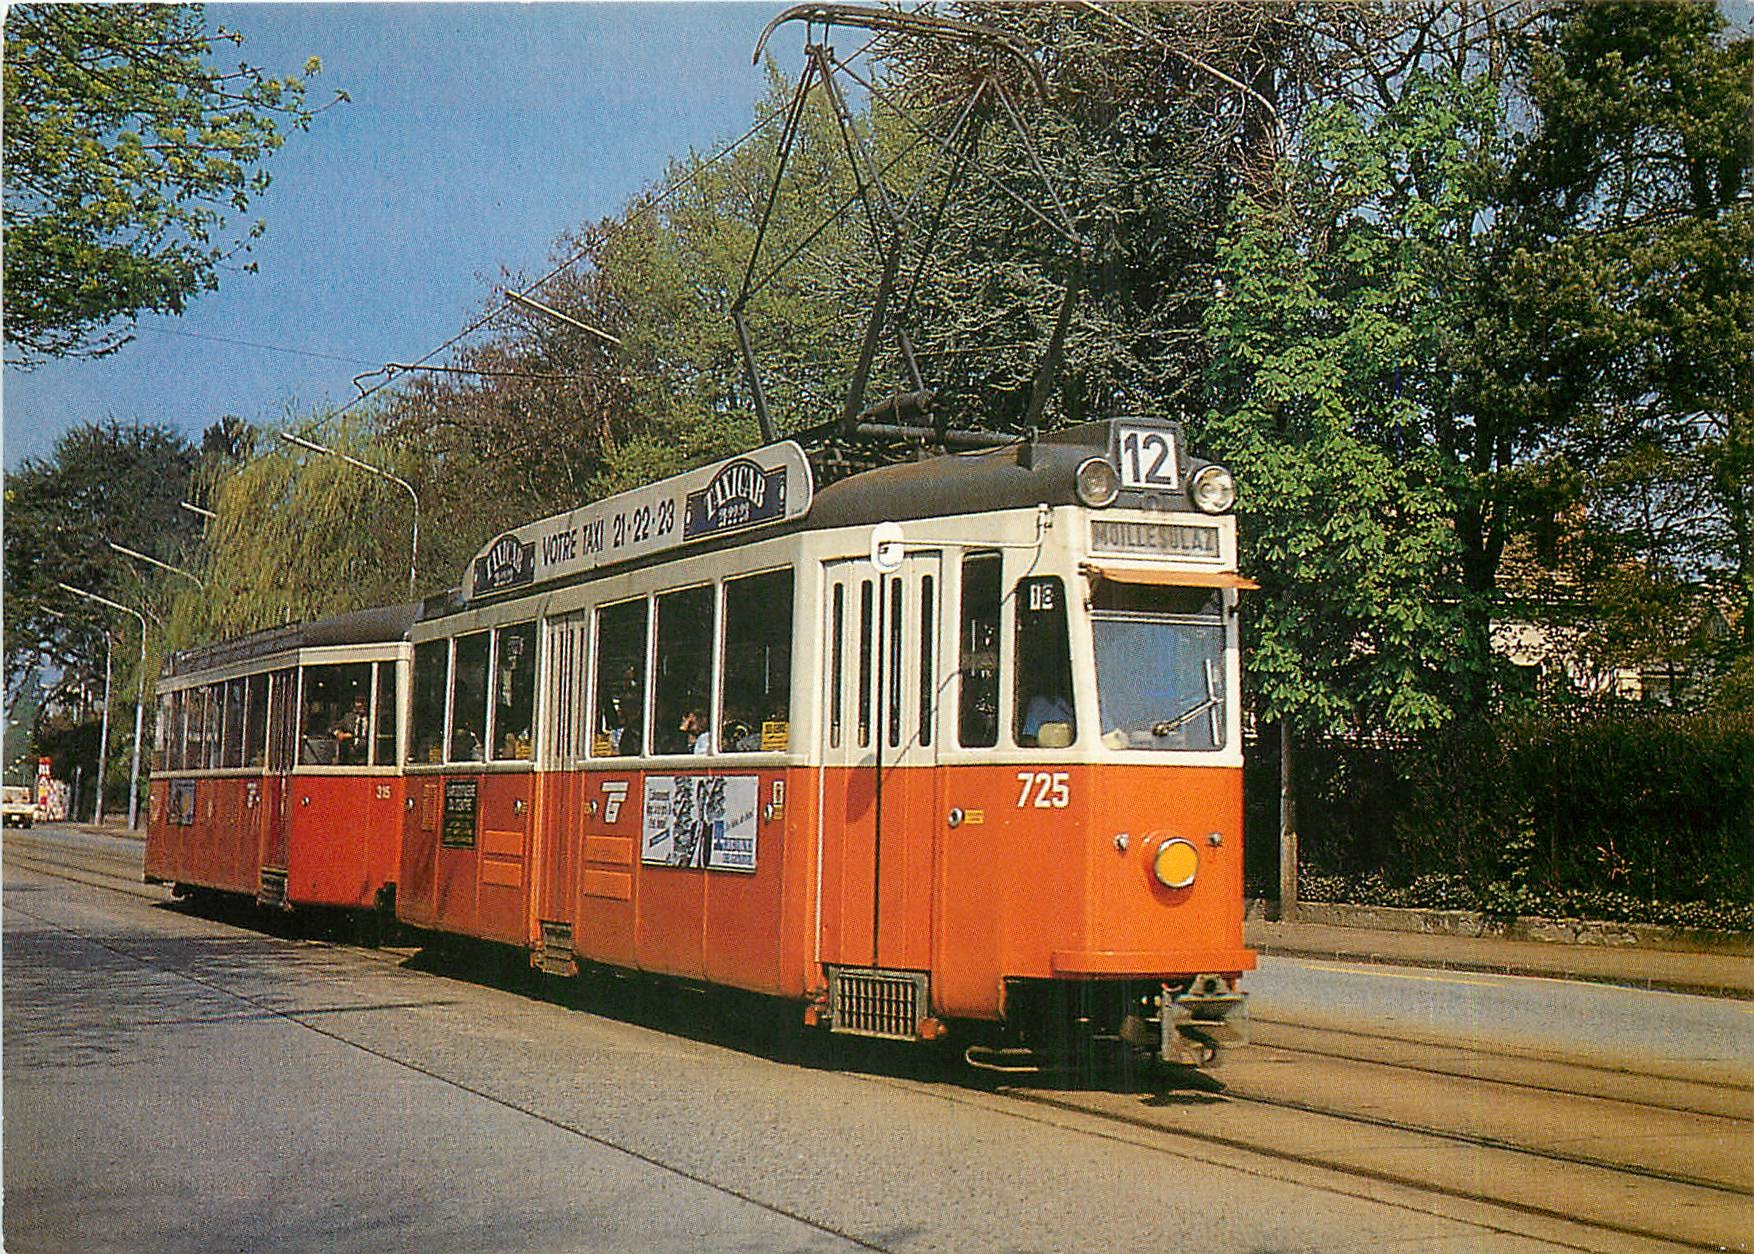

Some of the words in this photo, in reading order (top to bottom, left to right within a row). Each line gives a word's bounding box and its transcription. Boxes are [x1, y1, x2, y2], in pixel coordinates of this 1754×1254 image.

[1124, 432, 1171, 484] 12
[541, 527, 577, 566] VOTRE
[583, 518, 605, 555] TAXI
[1017, 771, 1070, 809] 725
